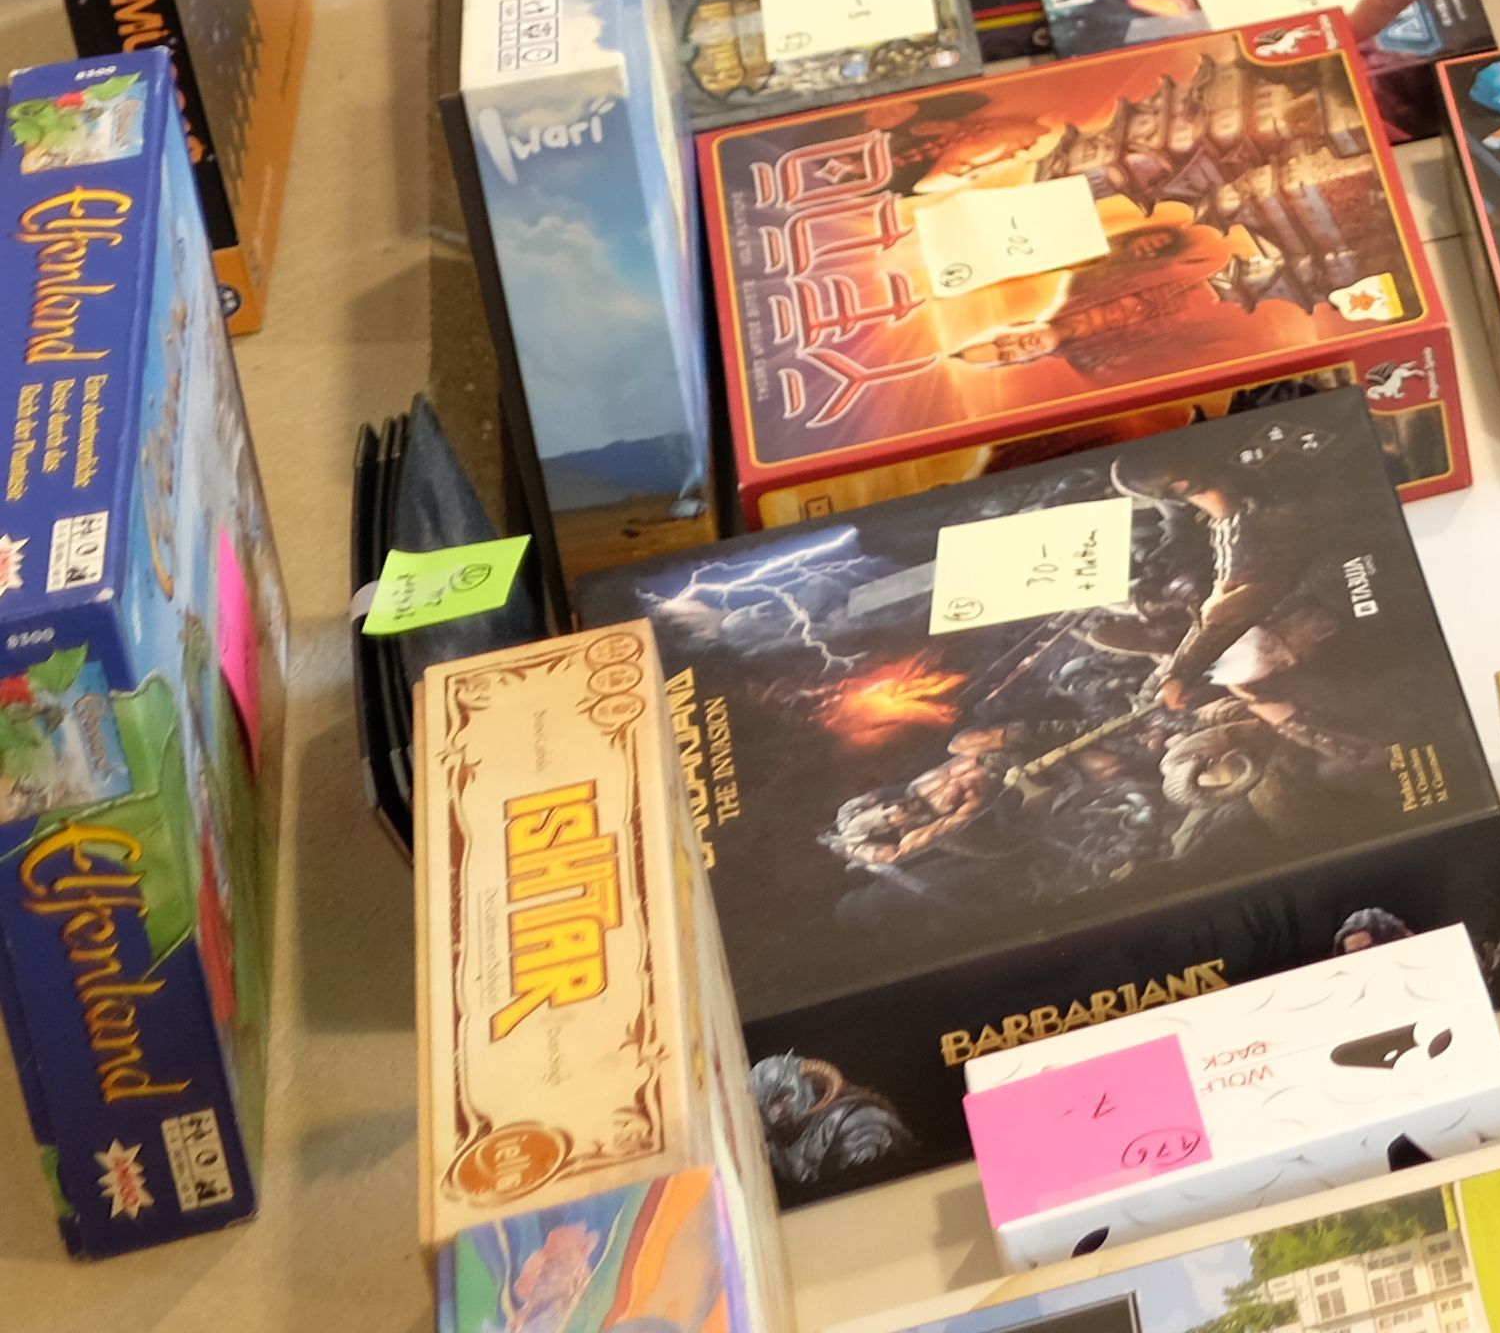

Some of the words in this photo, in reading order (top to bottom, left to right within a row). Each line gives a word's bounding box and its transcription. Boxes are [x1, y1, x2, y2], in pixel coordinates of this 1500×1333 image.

[477, 98, 617, 184] Iwari
[18, 186, 133, 365] Elfenland
[703, 695, 736, 782] INVASION
[713, 781, 742, 827] THE
[489, 778, 624, 1043] ISHTAR
[20, 821, 192, 1104] Elfenland
[1200, 1064, 1274, 1097] WOLF
[1203, 1040, 1269, 1071] PACK
